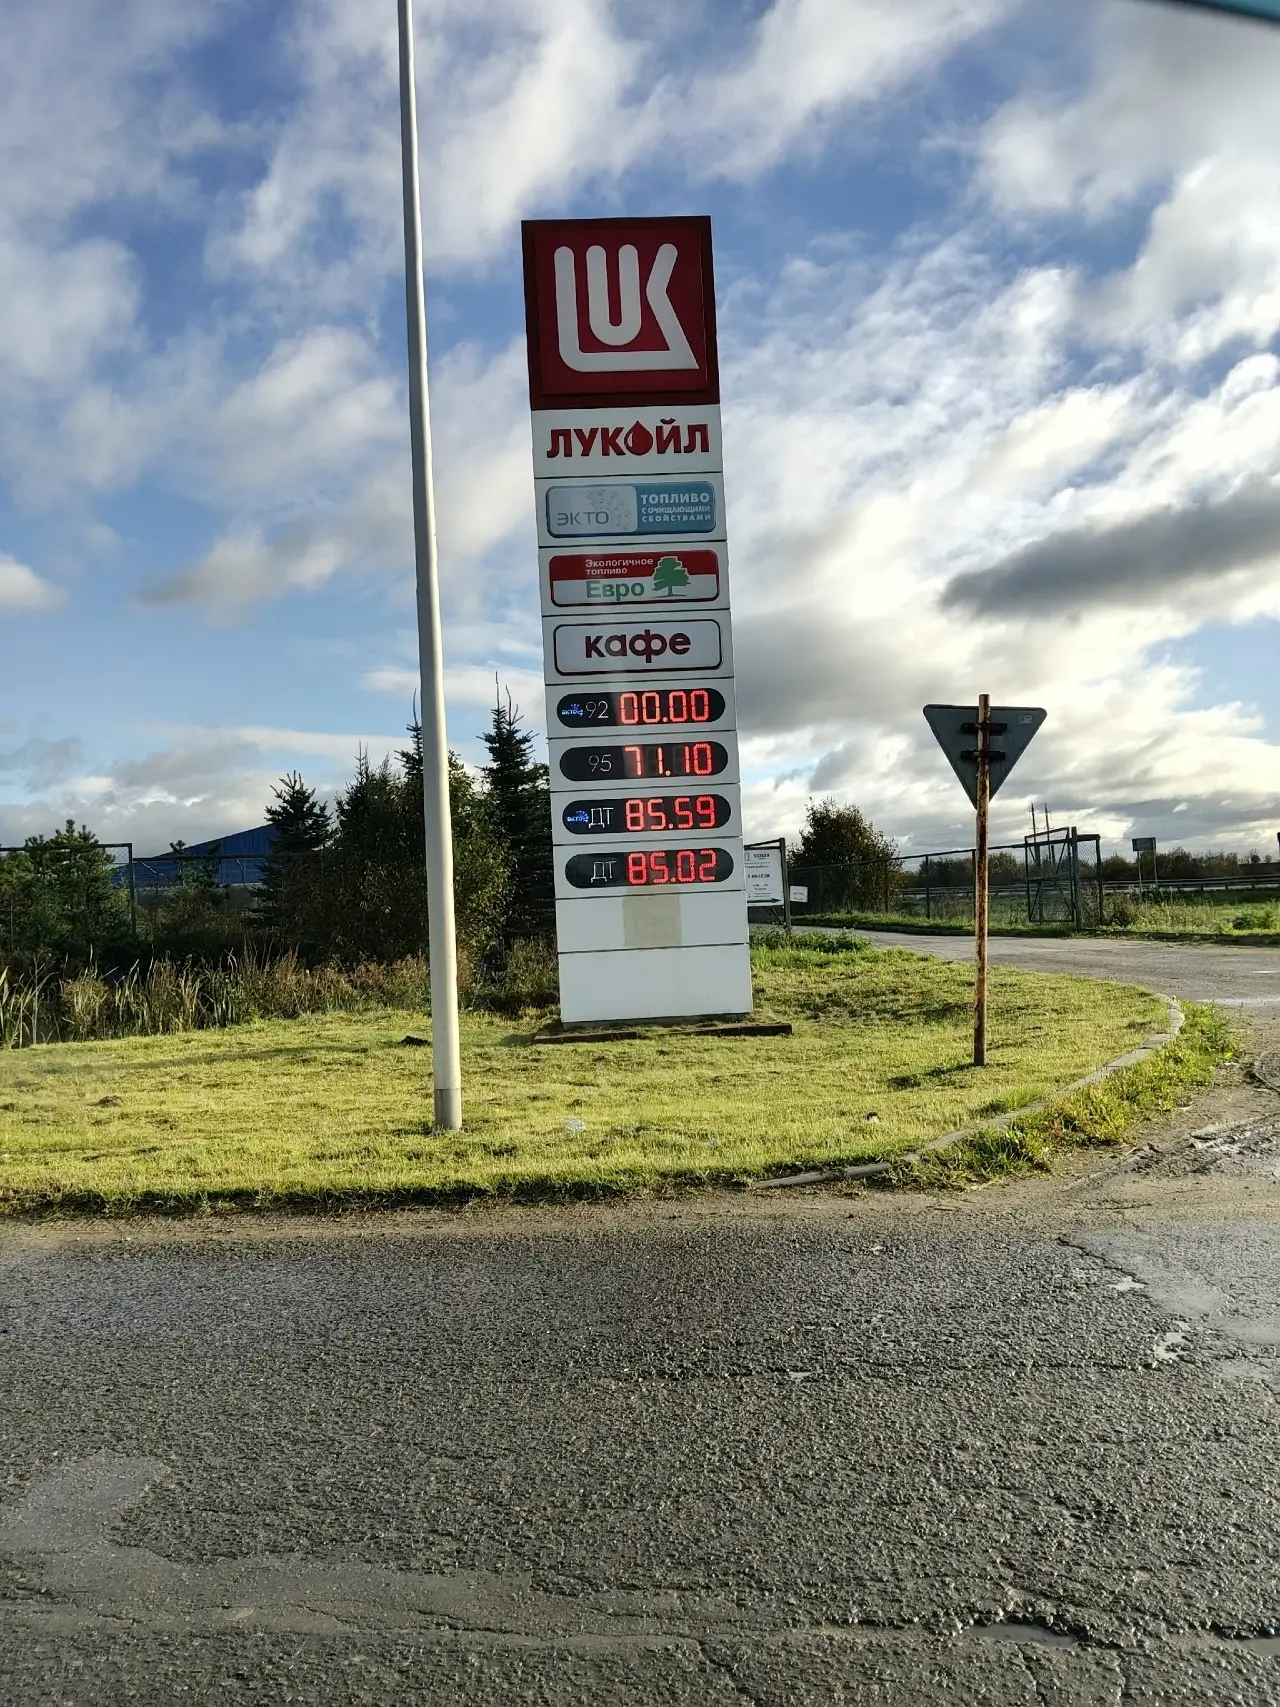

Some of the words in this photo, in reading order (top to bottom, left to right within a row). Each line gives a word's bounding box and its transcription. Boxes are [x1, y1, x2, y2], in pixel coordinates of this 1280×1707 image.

[546, 417, 710, 459] ЛУКОЙЛ
[640, 492, 710, 505] ТОПЛИВО
[557, 510, 610, 527] ЭКТО
[642, 514, 712, 523] СВОЙСТВАМИ
[585, 557, 654, 568] Экологичное
[585, 567, 628, 576] топливо
[586, 580, 645, 601] Евро
[584, 629, 692, 664] кафе
[585, 700, 610, 719] 92
[619, 690, 710, 725] 00.00
[588, 753, 613, 773] 95
[624, 743, 713, 777] 71.10
[588, 807, 615, 830] ДТ
[625, 796, 716, 832] 85.59
[590, 860, 617, 884] ДТ
[626, 850, 717, 886] 85.02
